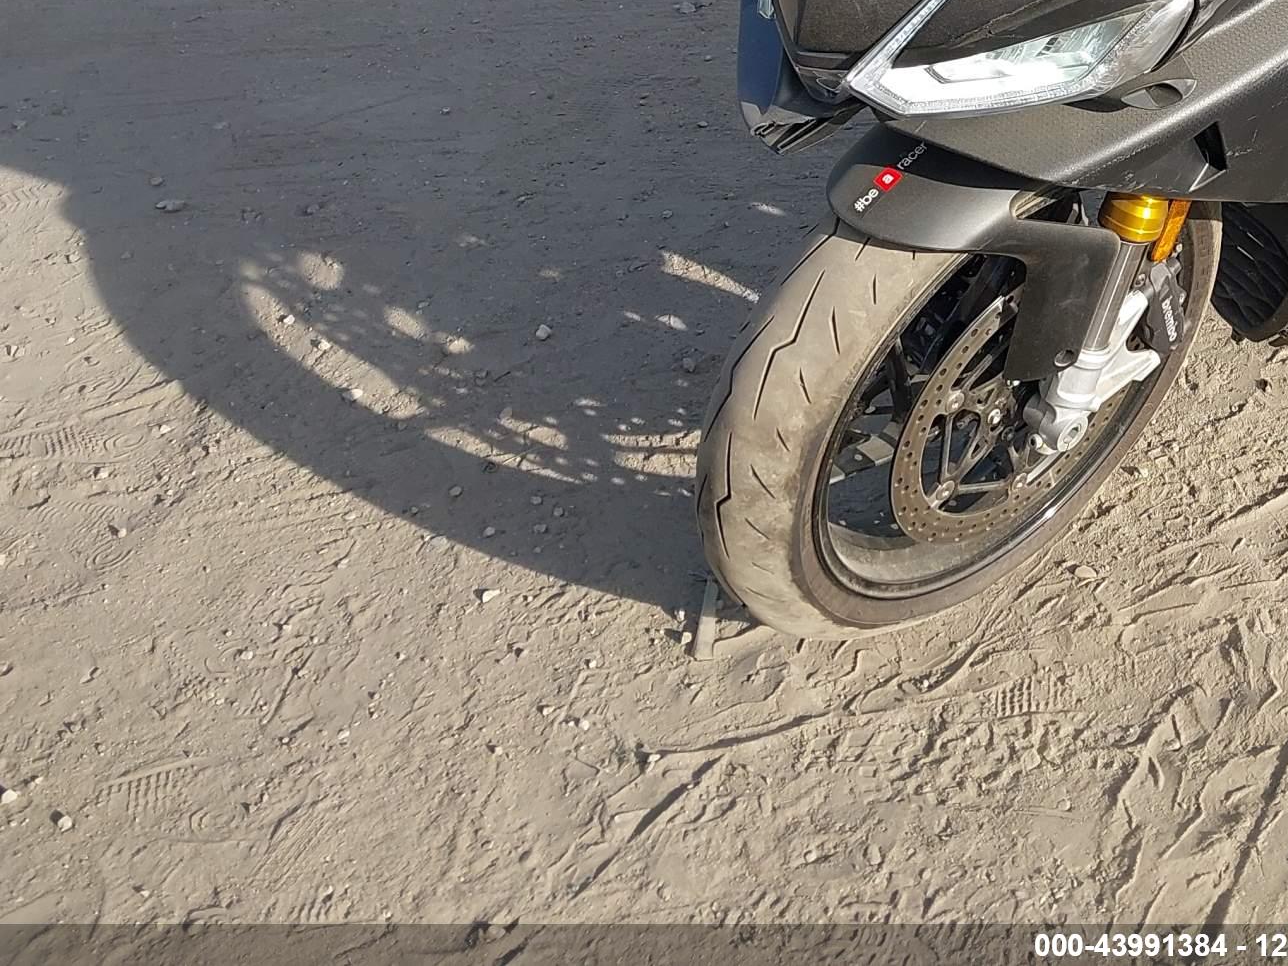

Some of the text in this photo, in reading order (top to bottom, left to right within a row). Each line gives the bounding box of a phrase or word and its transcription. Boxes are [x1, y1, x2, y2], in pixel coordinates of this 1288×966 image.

[854, 187, 880, 212] #be
[897, 141, 928, 170] racer
[1161, 295, 1178, 342] brembo
